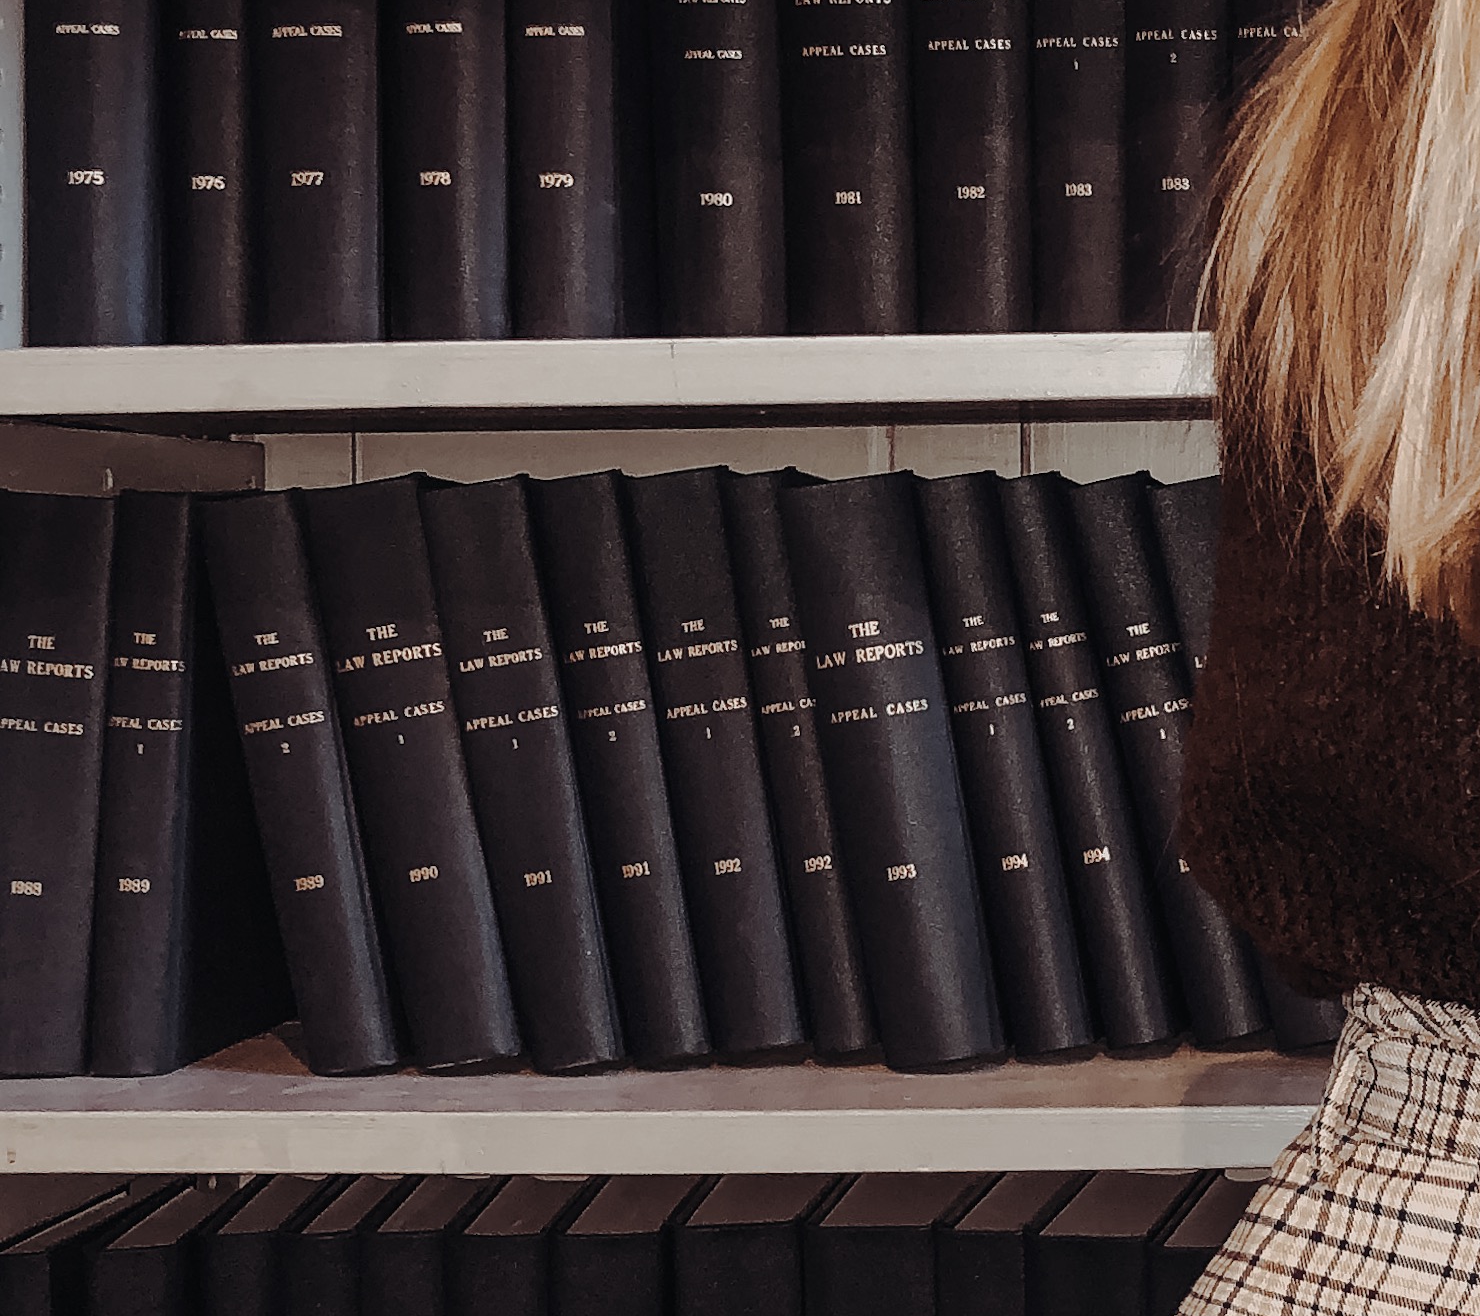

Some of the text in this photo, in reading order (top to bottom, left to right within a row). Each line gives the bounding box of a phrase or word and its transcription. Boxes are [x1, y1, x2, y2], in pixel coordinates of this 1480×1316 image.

[1036, 36, 1119, 48] APPEAL CASES
[802, 45, 886, 56] APPEAL CASES
[1169, 53, 1176, 63] 2
[68, 170, 104, 184] 1975
[291, 172, 324, 186] 1977
[419, 172, 451, 186] 1978
[540, 174, 574, 188] 1979
[956, 186, 985, 200] 1982
[1064, 184, 1092, 196] 1983
[701, 193, 733, 206] 1980
[834, 192, 861, 205] 1981
[366, 625, 398, 640] THE
[682, 620, 704, 632] THE
[849, 622, 880, 638] THE
[1127, 624, 1150, 636] THE
[484, 629, 508, 642] THE
[28, 636, 55, 650] THE
[658, 640, 738, 662] LAW REPORTS
[816, 642, 924, 669] LAW REPORTS
[460, 648, 543, 672] LAW REPORTS
[666, 698, 748, 718] APPEAL CASES
[830, 699, 928, 724] APPEAL CASES
[466, 706, 558, 732] APPEAL CASES
[44, 722, 84, 734] CASES
[706, 728, 711, 738] 1
[512, 739, 518, 749] 1
[714, 858, 742, 874] 1992
[804, 856, 832, 872] 1992
[1002, 854, 1028, 870] 1994
[409, 867, 438, 882] 1990
[524, 872, 552, 886] 1991
[886, 864, 916, 880] 1993
[119, 879, 150, 892] 1989
